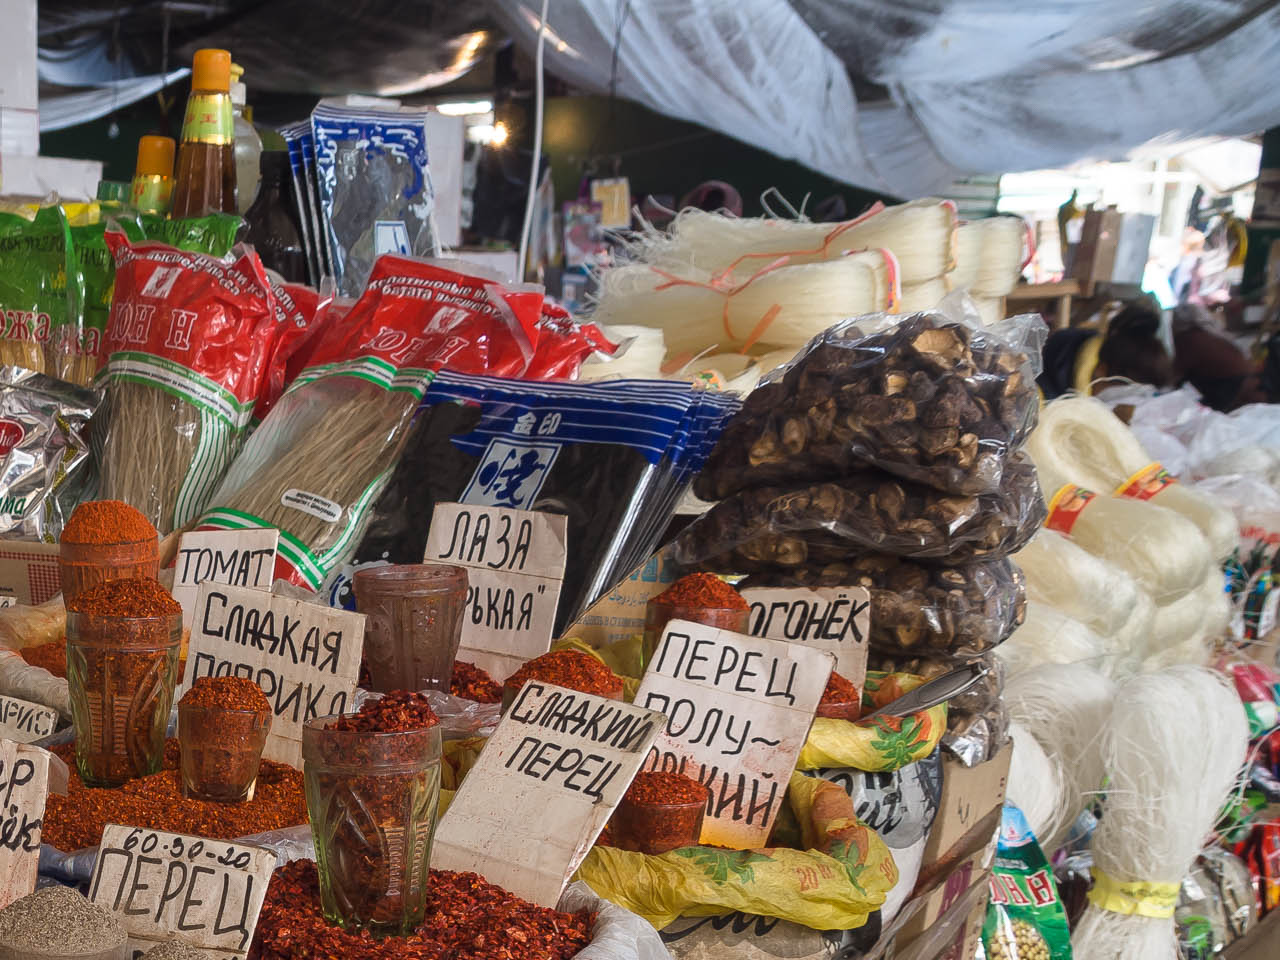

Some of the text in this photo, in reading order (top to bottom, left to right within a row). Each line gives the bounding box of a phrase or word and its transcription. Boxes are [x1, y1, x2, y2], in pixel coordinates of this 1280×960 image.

[179, 547, 275, 588] ТОМАТ
[439, 510, 533, 571] ЛАЗА
[748, 592, 869, 644] ОГОНЁК
[655, 631, 798, 706] ПЕРЕЦ
[510, 683, 657, 752] СЛАДКИЙ
[505, 737, 624, 803] ПЕРЕЦ
[88, 847, 255, 950] ПЕРЕЦ
